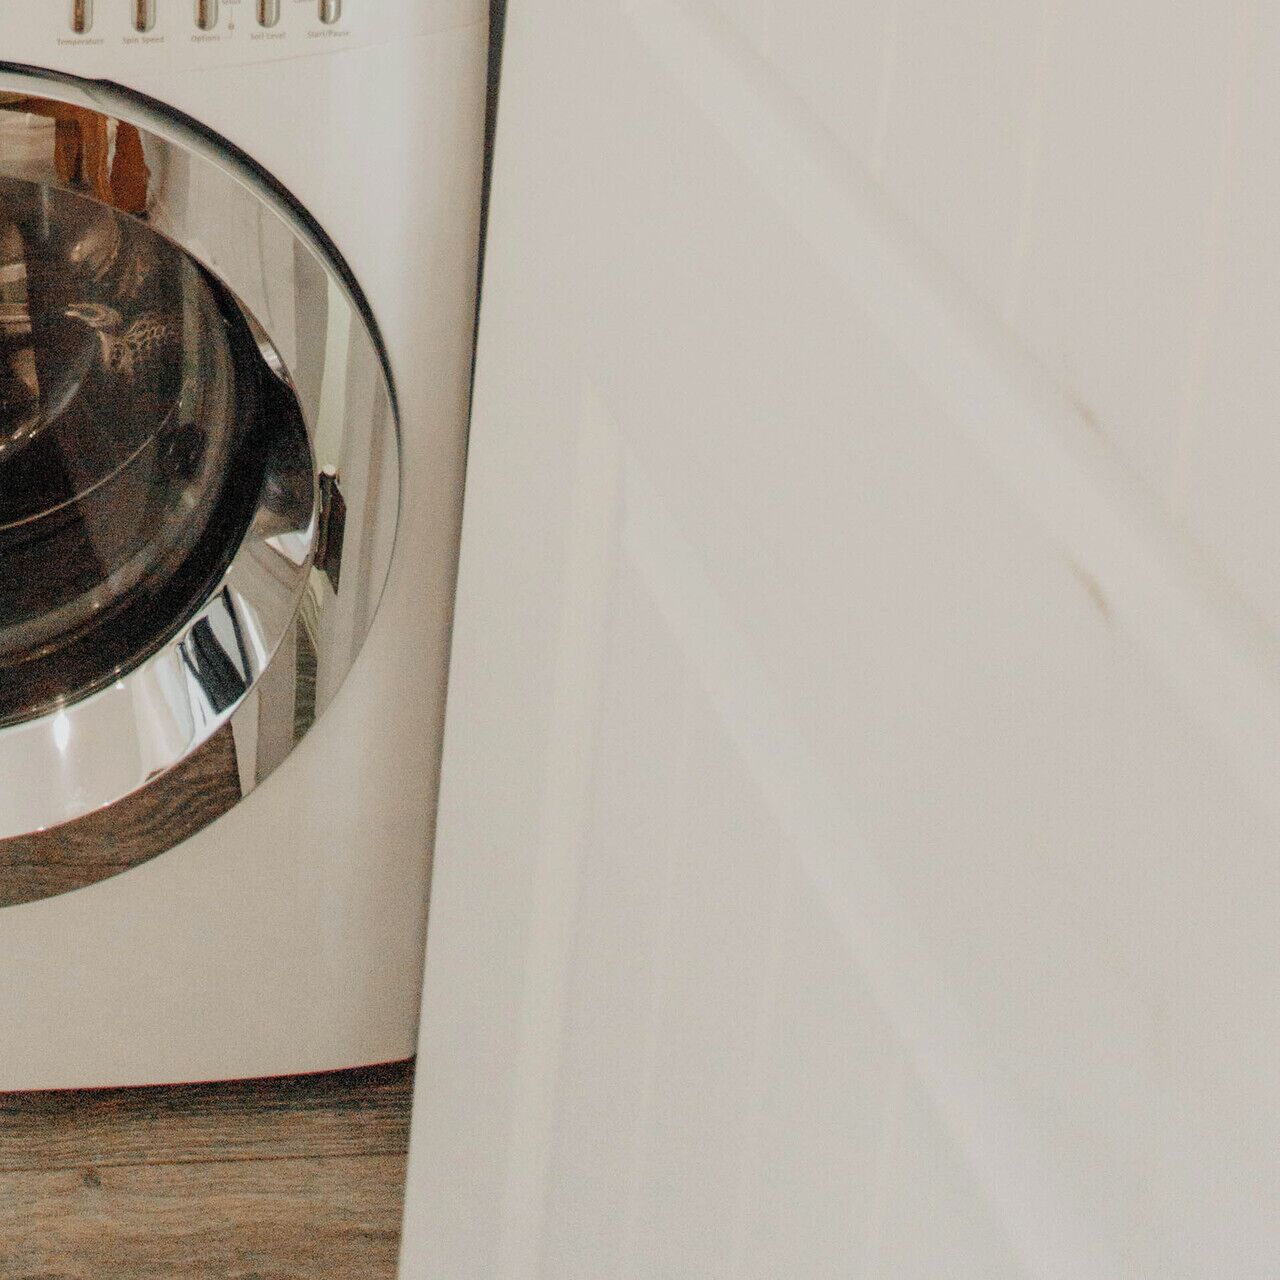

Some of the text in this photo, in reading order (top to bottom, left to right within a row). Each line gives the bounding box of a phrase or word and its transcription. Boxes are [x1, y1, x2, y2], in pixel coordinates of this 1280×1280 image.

[190, 33, 221, 43] Options
[268, 31, 287, 40] Level
[307, 28, 350, 39] Start/Pause
[56, 37, 105, 47] Temperature
[122, 35, 165, 46] Spin Speed
